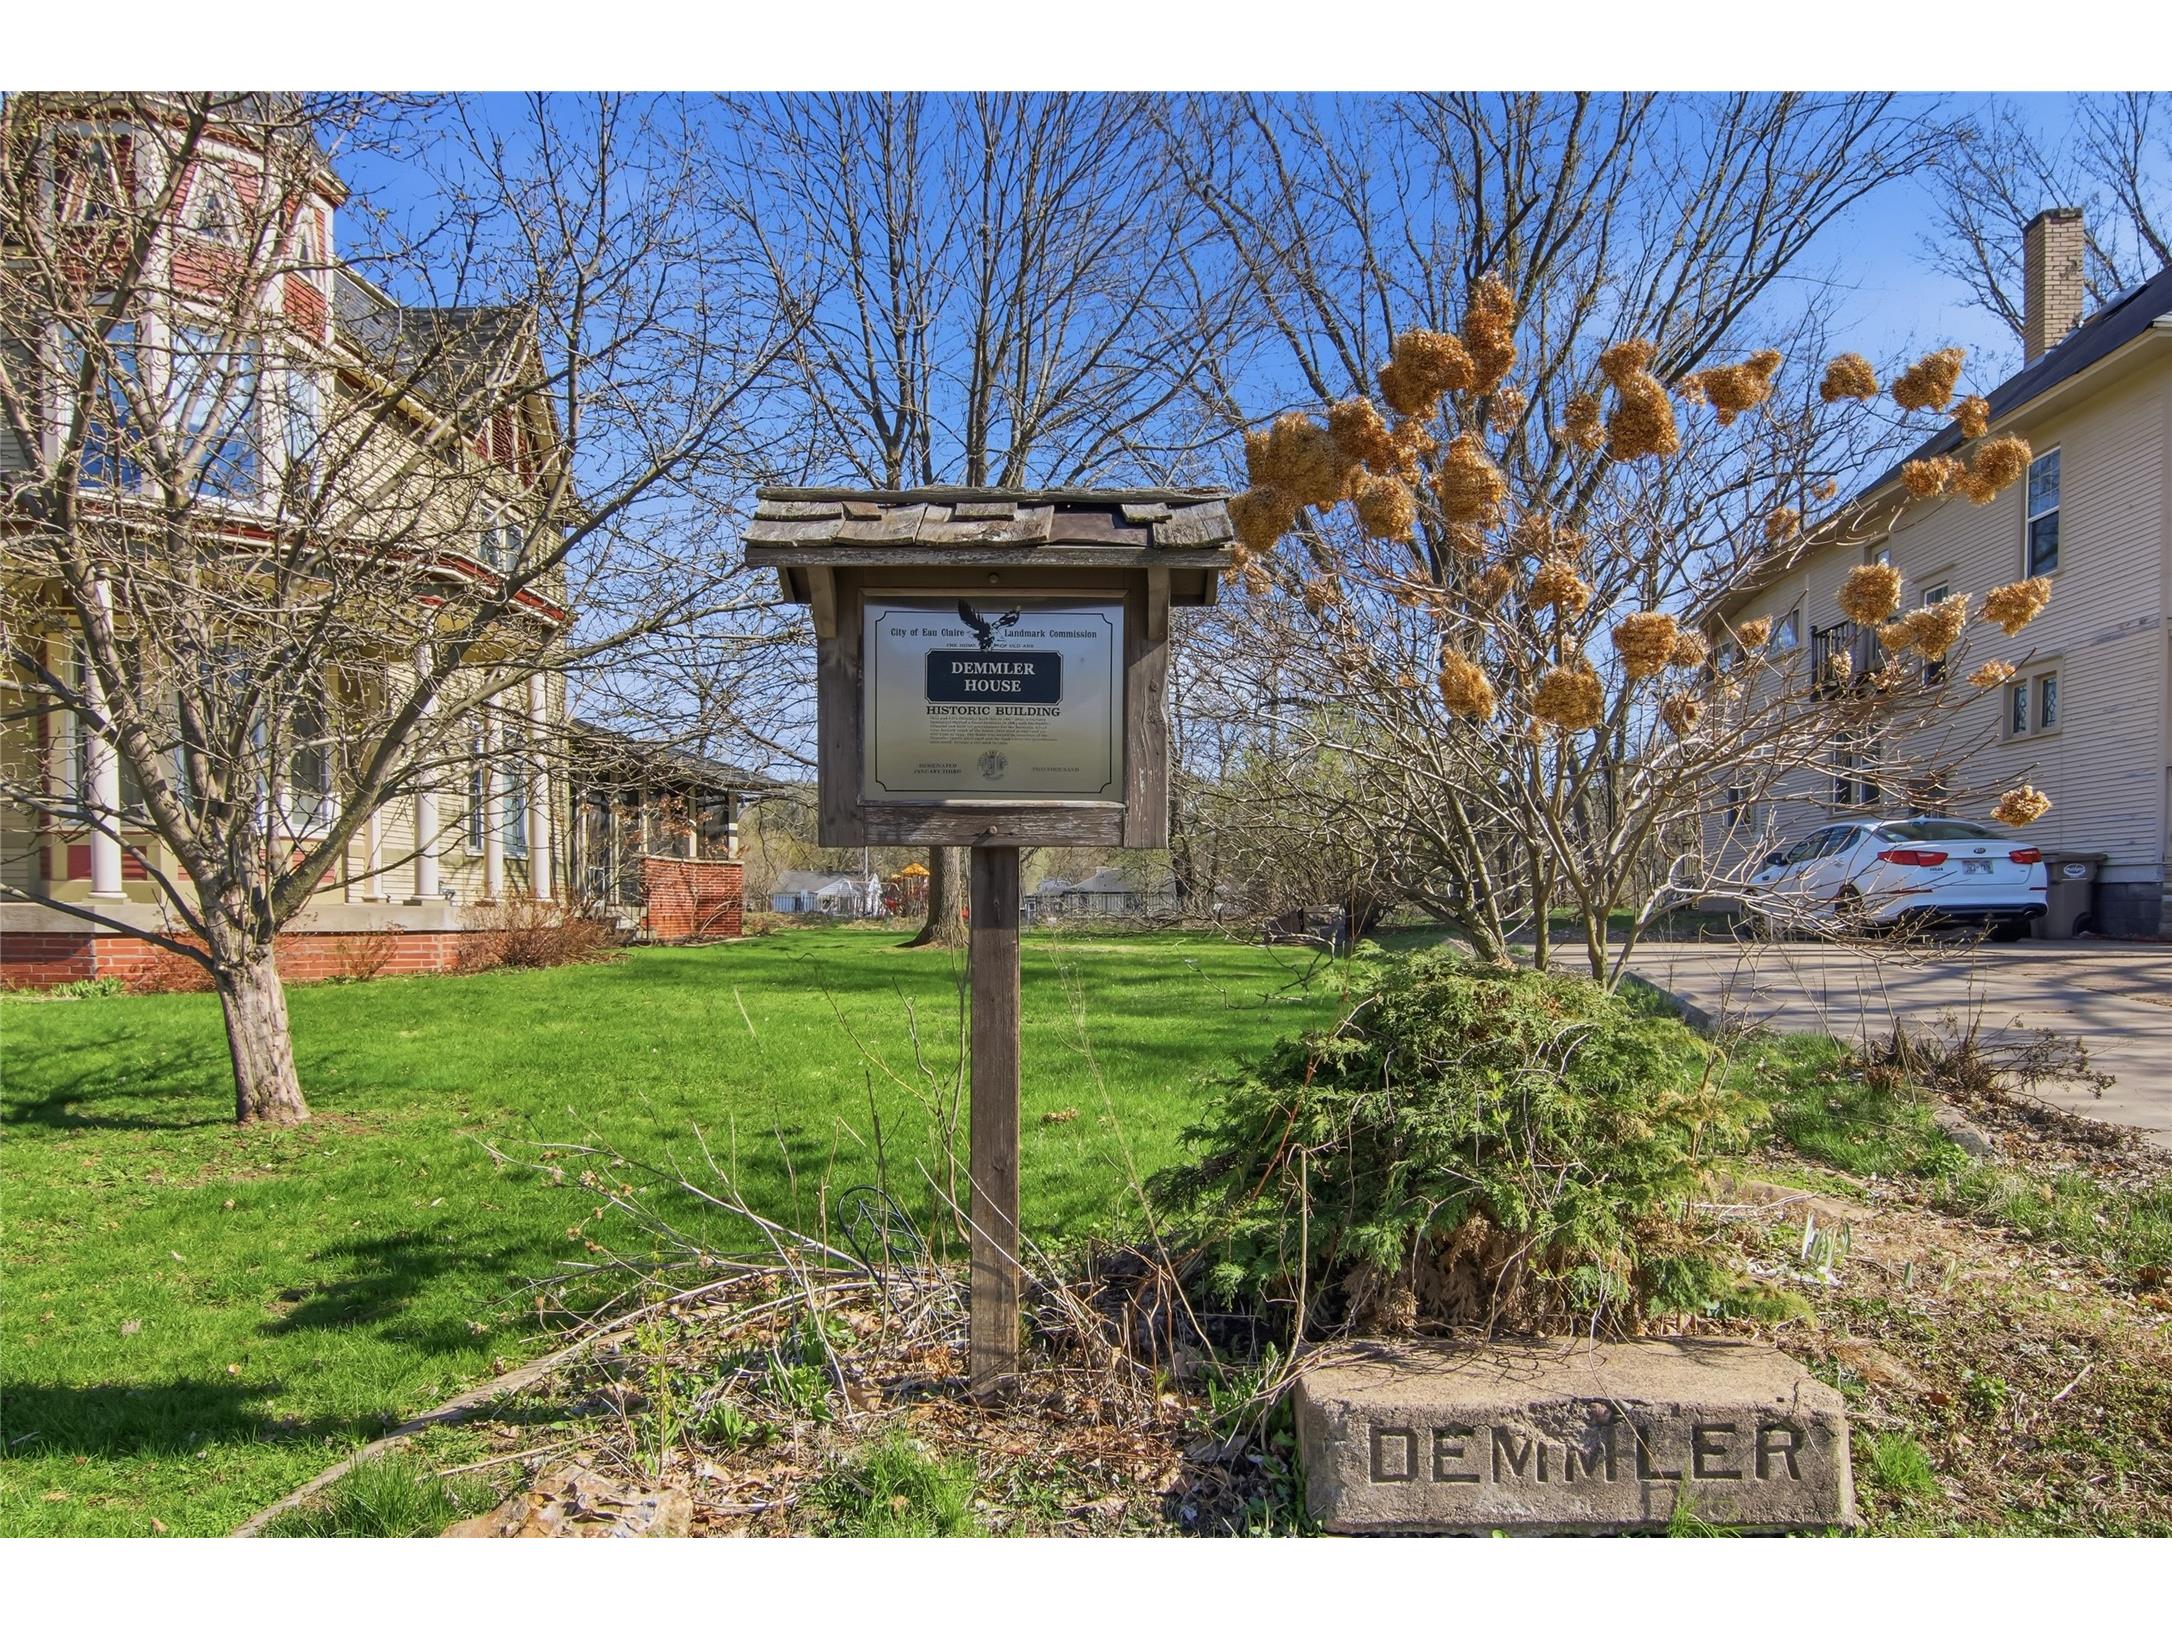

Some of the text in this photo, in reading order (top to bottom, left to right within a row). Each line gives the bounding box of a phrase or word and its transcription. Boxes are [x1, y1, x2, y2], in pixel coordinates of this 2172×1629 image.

[890, 628, 1097, 639] City of Eau Claire Landmark Commission
[951, 661, 1036, 675] DEMMLER
[963, 679, 1022, 692] HOUSE
[926, 705, 1061, 717] HISTORIC BUILDING
[1369, 1420, 1800, 1484] DEMMLER
